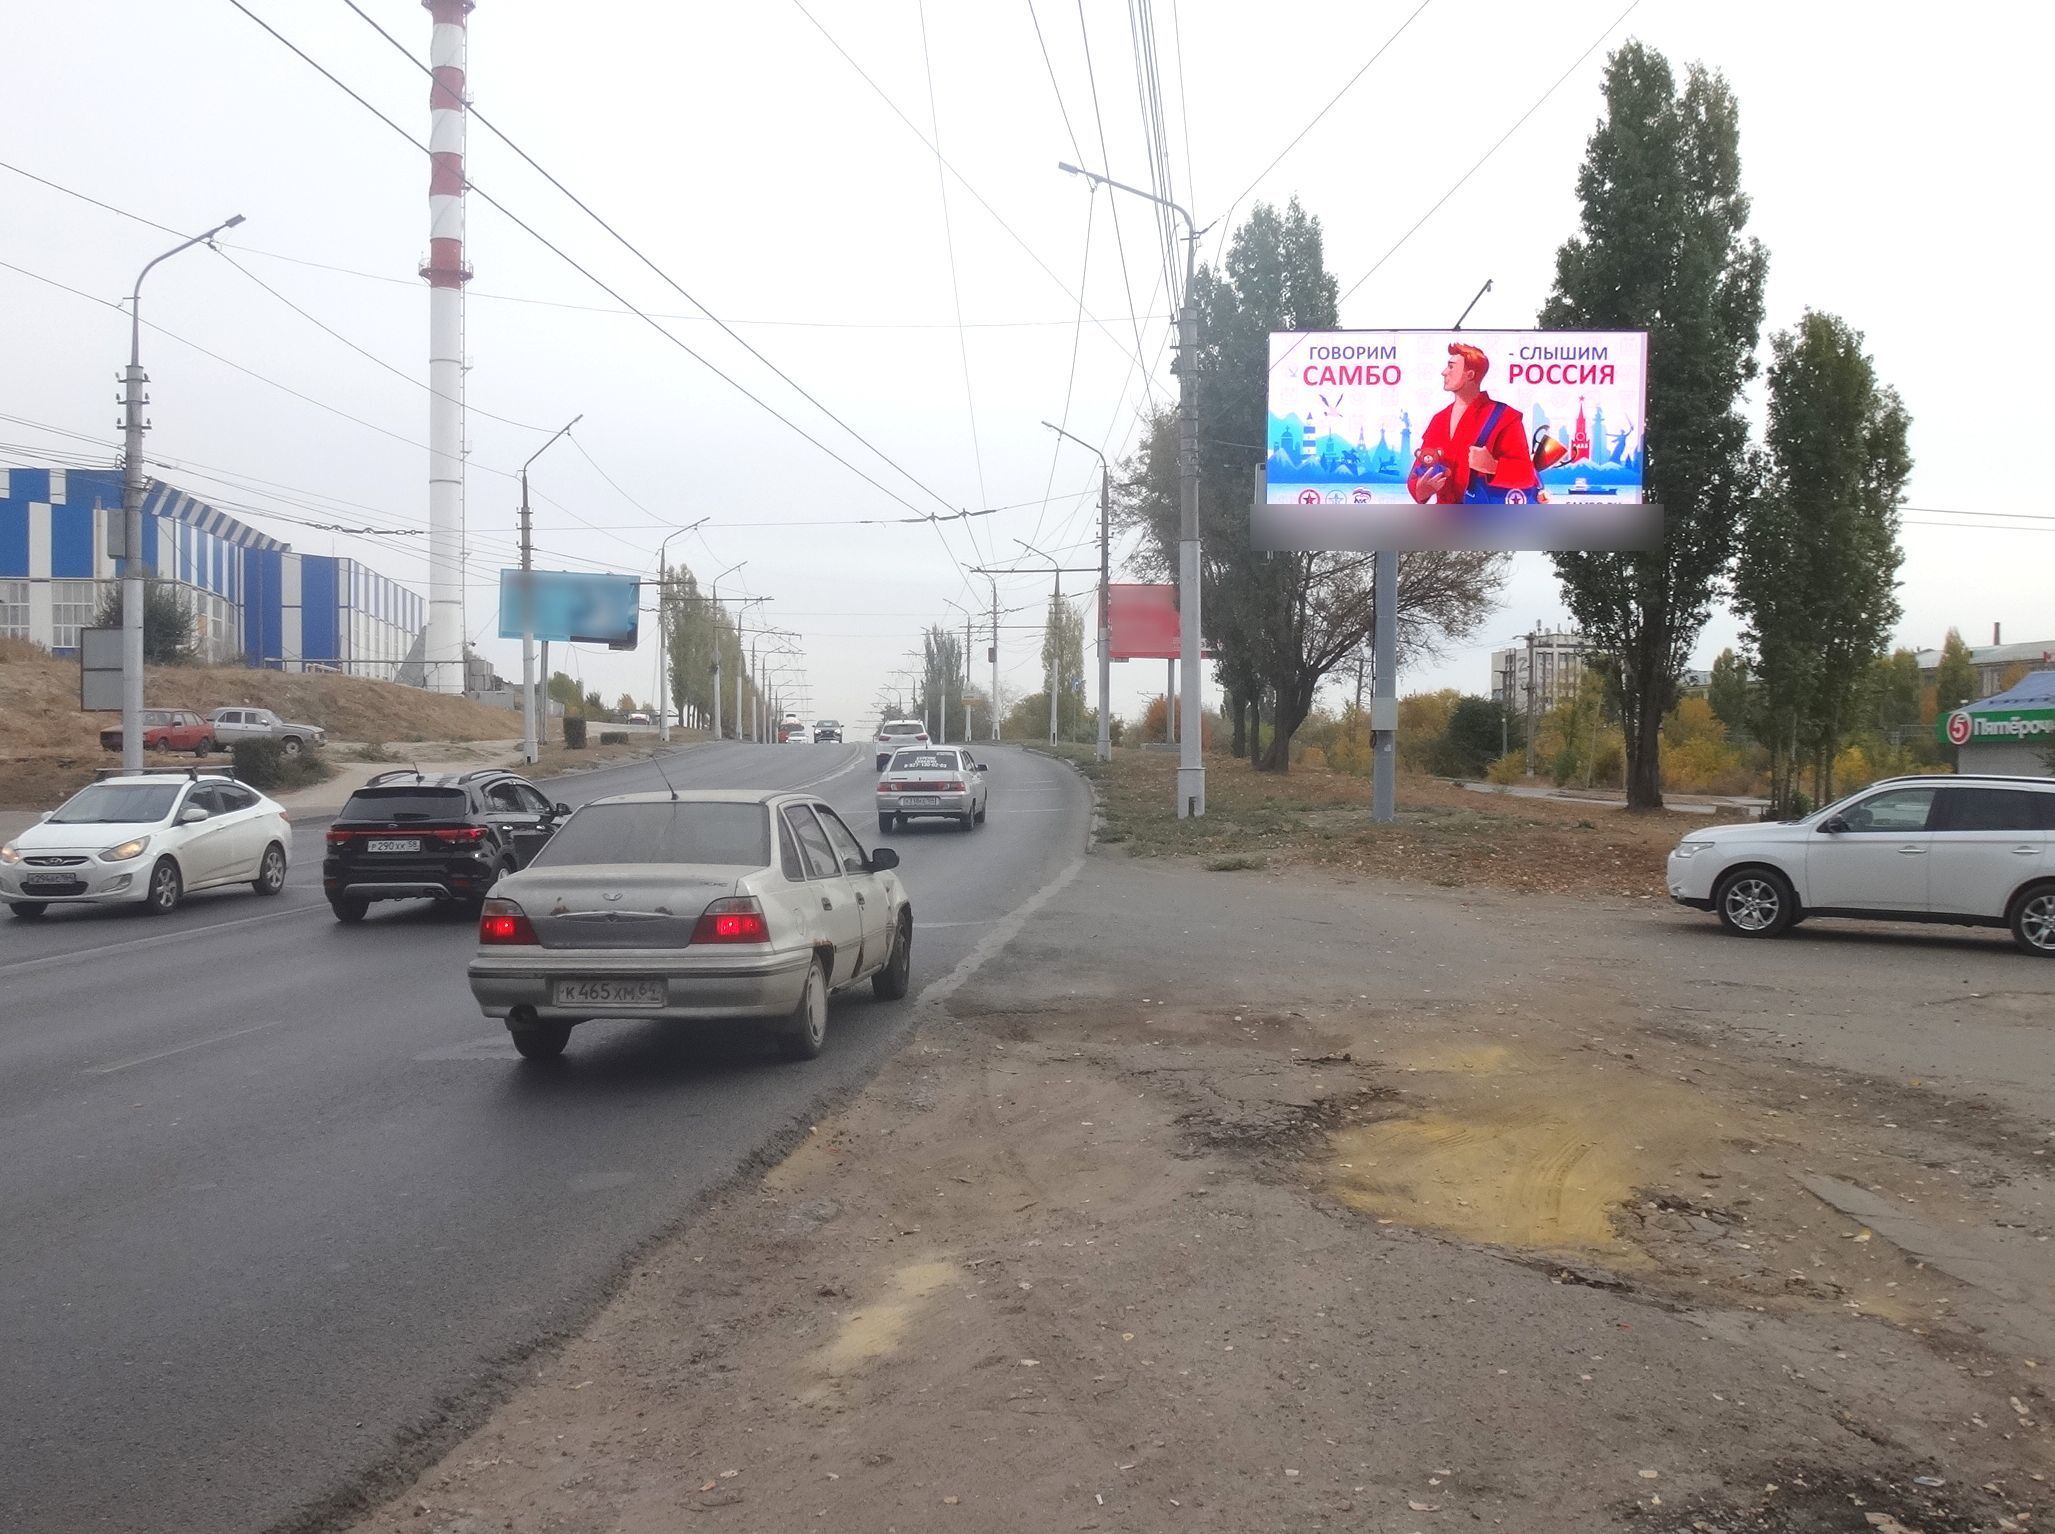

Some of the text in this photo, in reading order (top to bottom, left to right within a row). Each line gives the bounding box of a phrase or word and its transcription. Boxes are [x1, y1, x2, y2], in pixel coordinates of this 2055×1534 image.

[1309, 346, 1397, 360] ГОВОРИМ
[1519, 346, 1608, 360] СЛЫШИМ
[1303, 365, 1402, 386] САМБО
[1509, 364, 1615, 385] РОССИЯ
[1952, 715, 2055, 739] 5 Пятёроч
